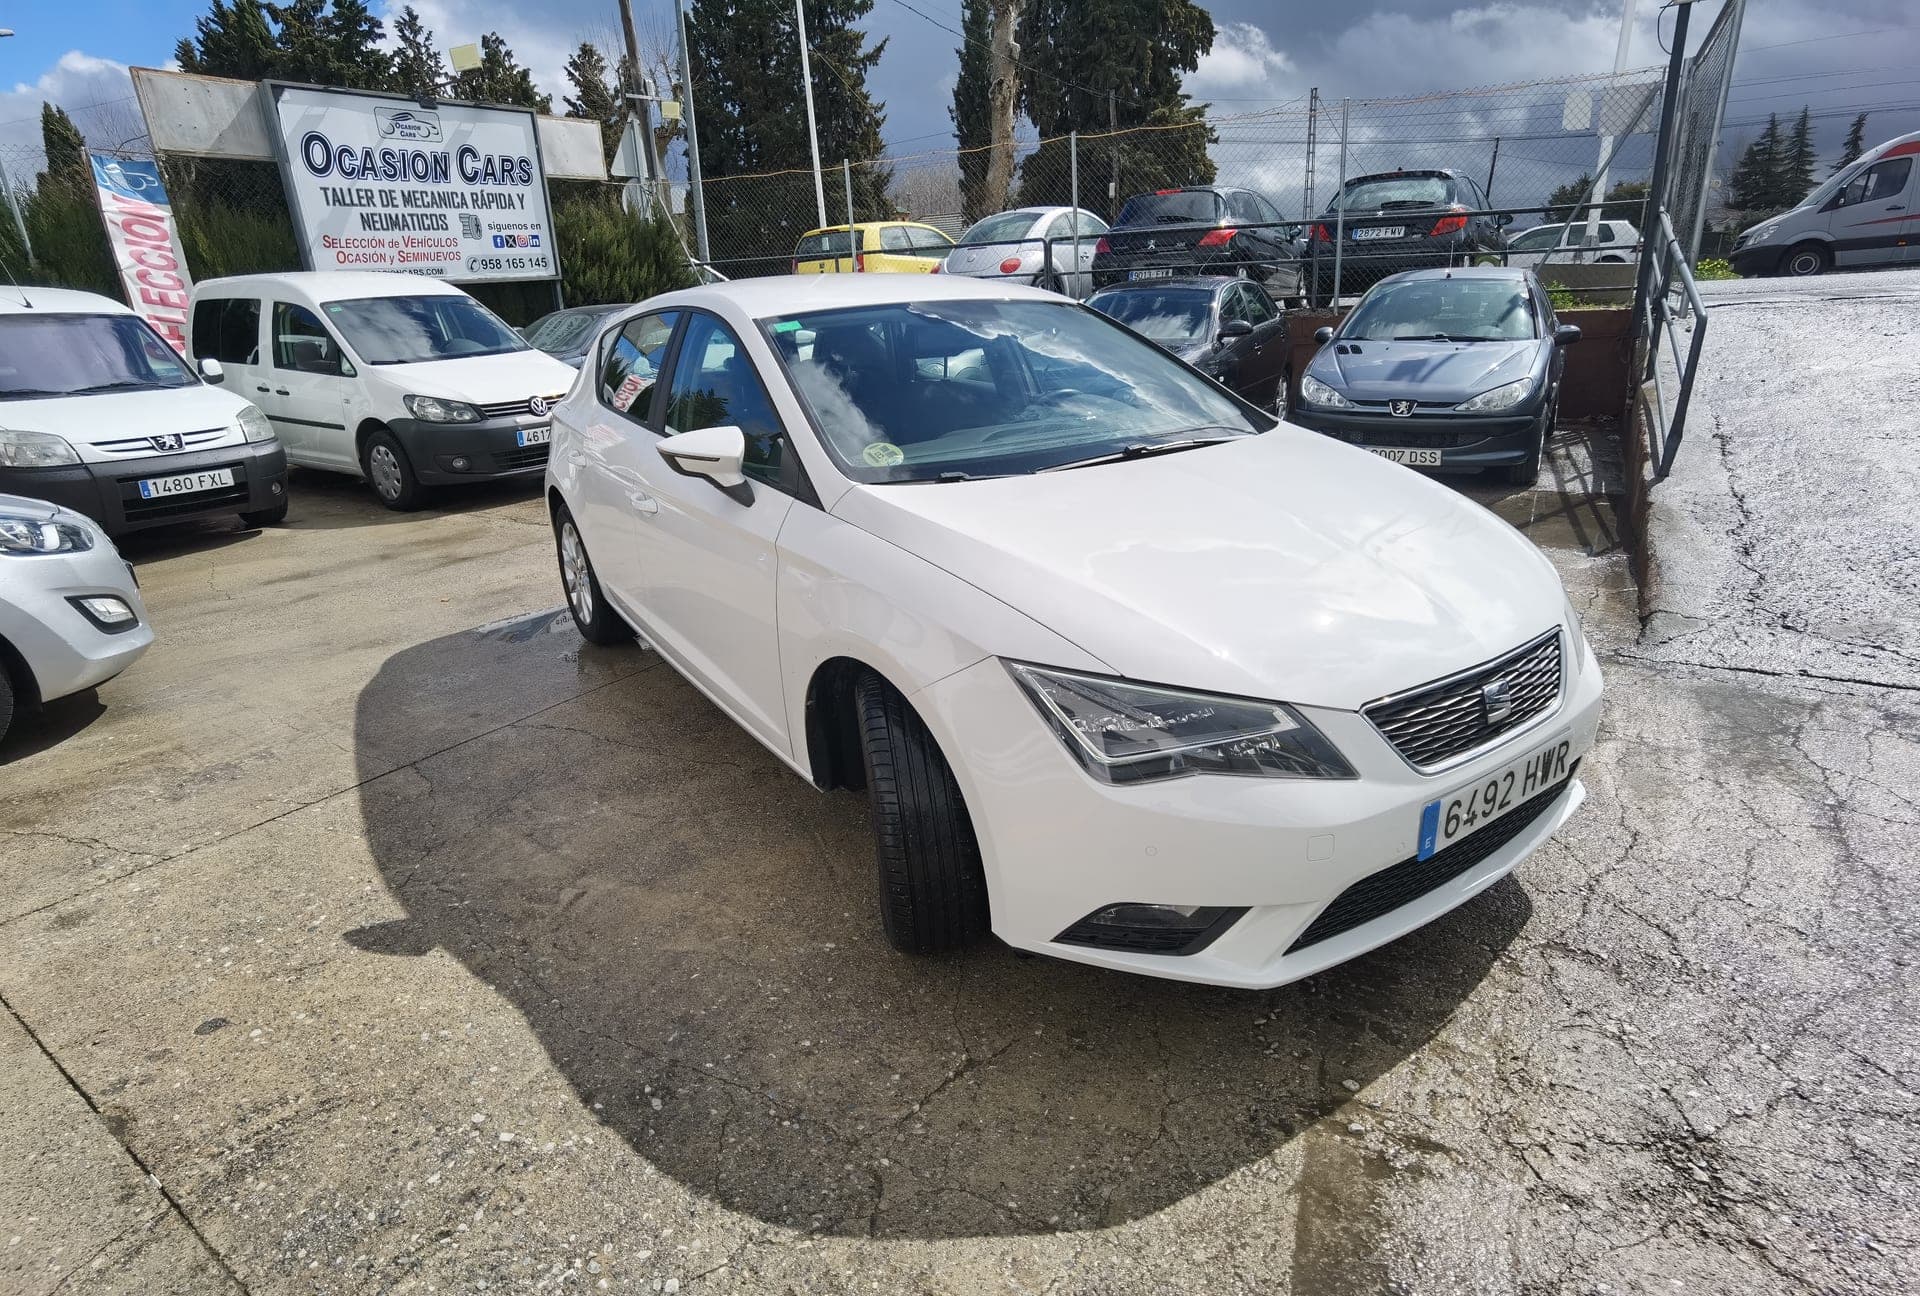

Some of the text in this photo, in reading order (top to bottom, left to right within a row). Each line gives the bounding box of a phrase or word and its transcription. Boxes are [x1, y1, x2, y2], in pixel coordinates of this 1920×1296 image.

[301, 131, 533, 187] OCASION CARS
[320, 187, 525, 210] TALLER DE MECANICA RÁPIDA Y
[360, 212, 449, 232] NEUMATICOS
[530, 223, 541, 231] en
[323, 235, 458, 249] SELECCIÓN de VEHÍCULOS
[336, 250, 461, 265] OCASIÓN y SEMINUEVOS
[481, 257, 548, 270] 958 165 145
[526, 429, 551, 442] 4617
[1409, 450, 1437, 463] DSS
[152, 473, 228, 495] 1480 FXL
[1444, 740, 1569, 839] 6492 HWR
